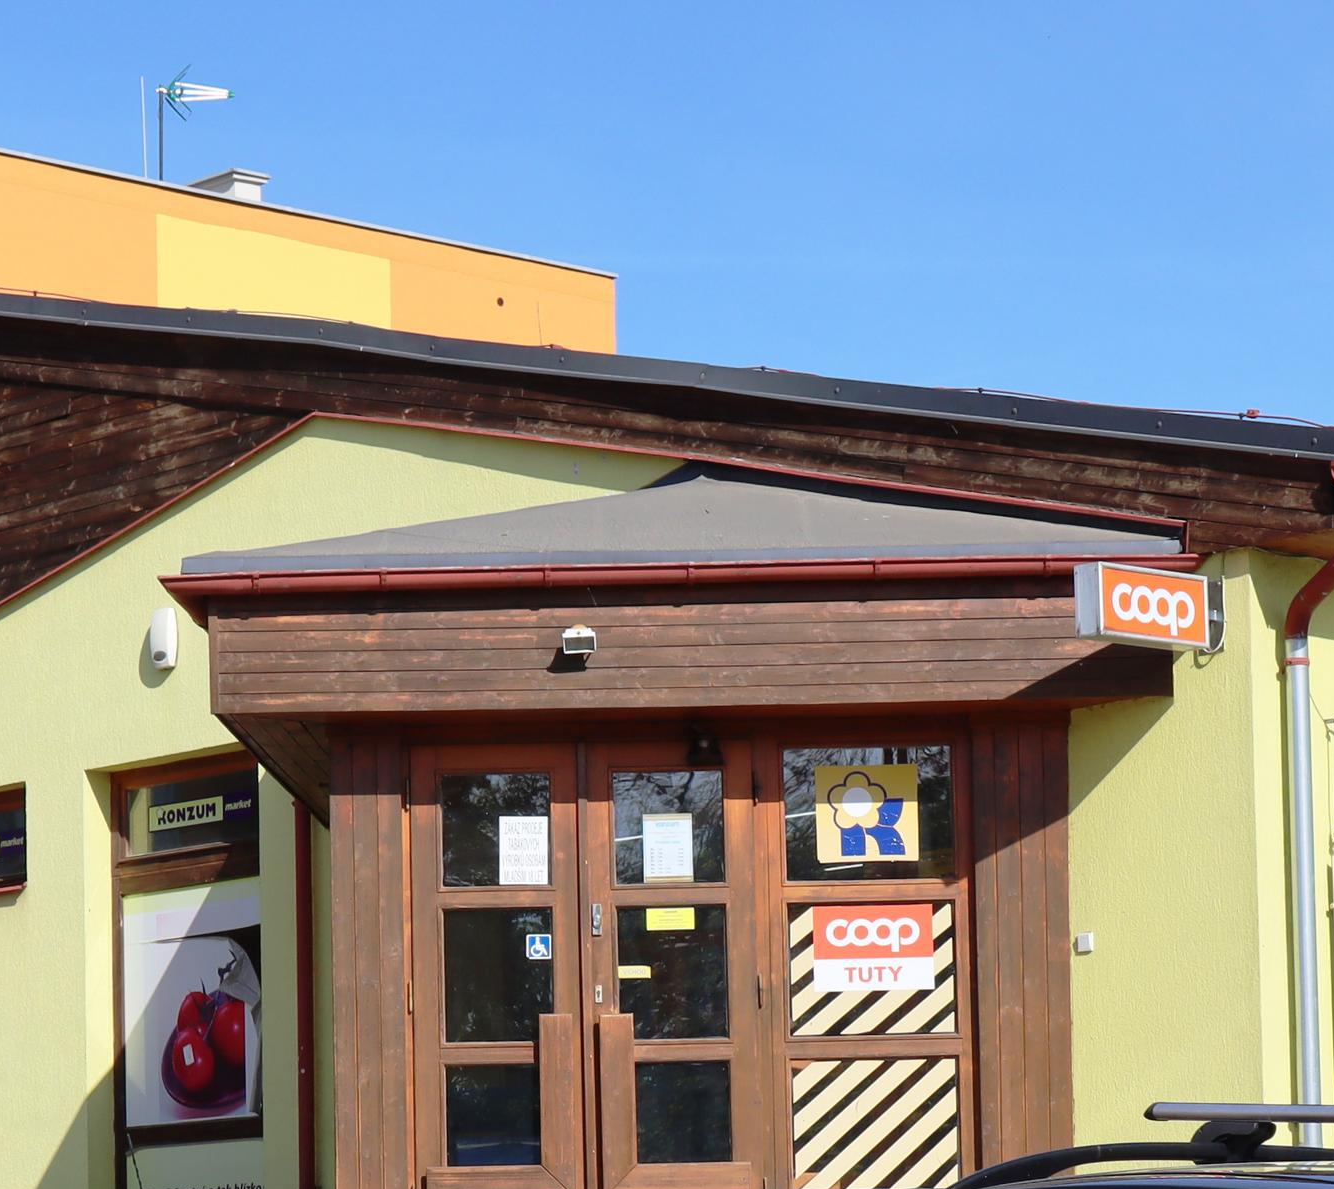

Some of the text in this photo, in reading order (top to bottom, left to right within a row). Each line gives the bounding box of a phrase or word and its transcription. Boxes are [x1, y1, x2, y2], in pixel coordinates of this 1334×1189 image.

[1112, 583, 1195, 636] coop
[225, 798, 251, 812] market
[0, 836, 24, 849] market
[825, 917, 921, 952] coop
[844, 965, 903, 983] TUTY
